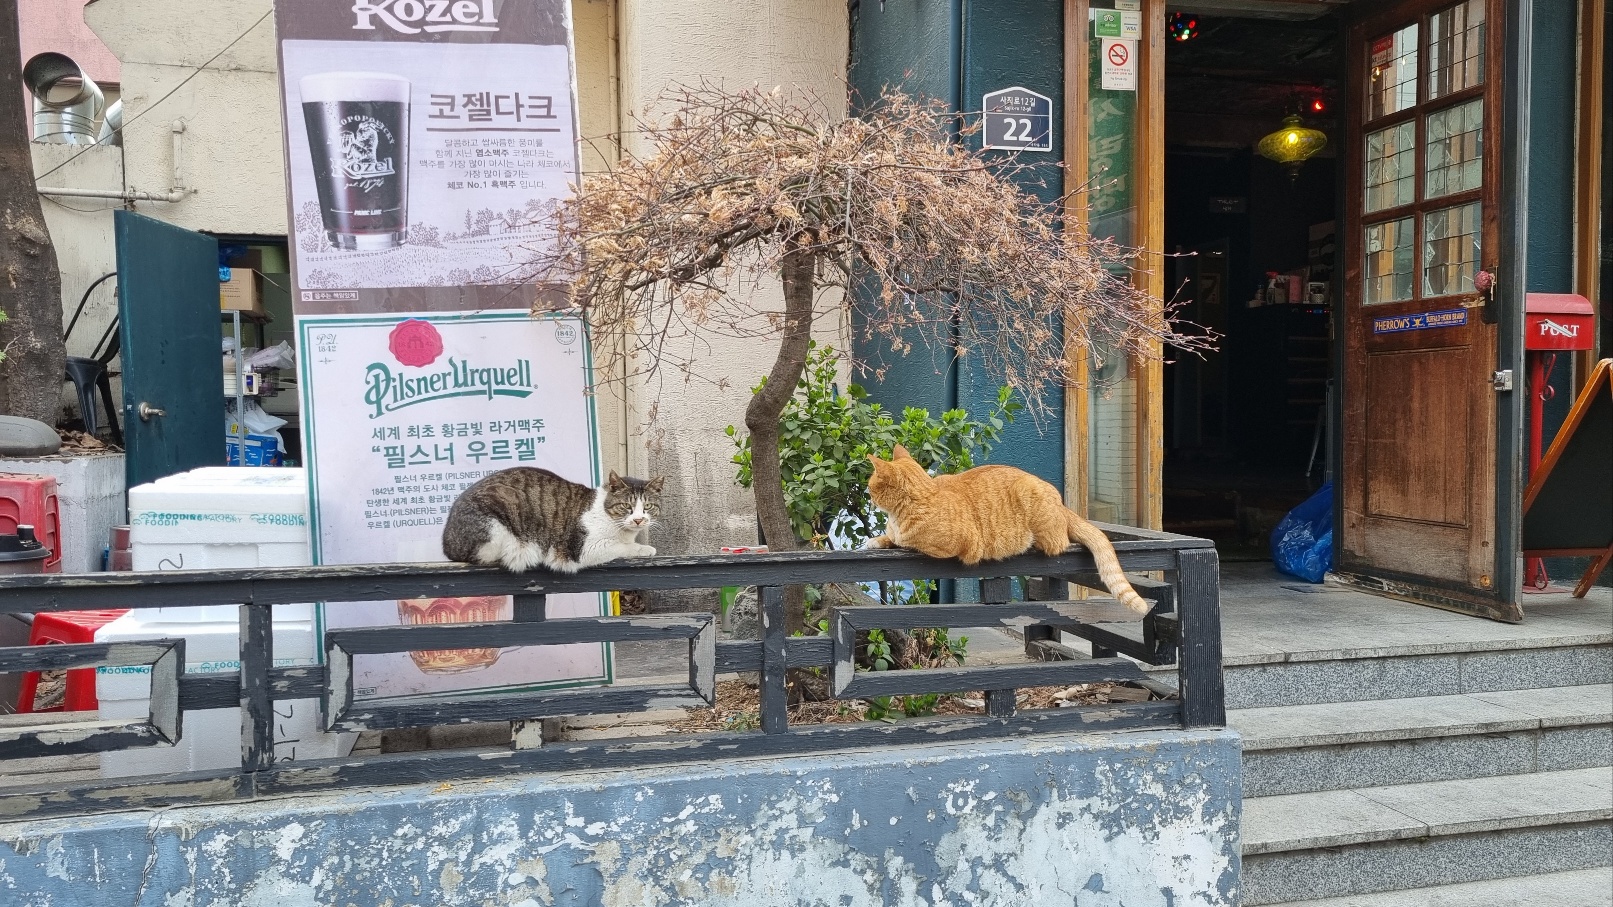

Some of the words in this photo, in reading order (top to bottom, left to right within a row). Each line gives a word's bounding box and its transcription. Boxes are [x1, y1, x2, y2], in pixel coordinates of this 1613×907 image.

[428, 92, 557, 122] 코젤다크
[1000, 96, 1036, 107] 사직로12길
[1003, 117, 1033, 142] 22
[444, 138, 478, 148] 달콤하고
[481, 138, 516, 148] 쌉싸름한
[519, 138, 543, 147] 풍미를
[435, 149, 453, 158] 함께
[456, 149, 472, 157] 지닌
[475, 148, 509, 157] 염소맥주
[512, 149, 555, 158] 코젤다크는
[329, 157, 396, 179] Kozel
[419, 159, 445, 169] 맥주를
[449, 159, 466, 169] 가장
[469, 159, 486, 168] 많이
[489, 159, 514, 168] 마시는
[517, 159, 534, 168] 나라
[537, 159, 571, 169] 체코에서
[464, 170, 480, 178] 가장
[483, 170, 501, 178] 많이
[504, 169, 530, 178] 즐기는
[447, 181, 464, 190] 체코
[467, 181, 487, 189] No.1
[490, 180, 517, 189] 흑맥주
[520, 181, 547, 190] 입니다.
[1374, 318, 1410, 331] PHERROW'S
[365, 362, 451, 419] Pilsner
[449, 356, 532, 401] Urquell
[371, 425, 401, 441] 세계
[407, 424, 436, 440] 최초
[441, 421, 483, 438] 황금빛
[489, 418, 546, 435] 라거맥주
[371, 442, 455, 469] “필스너
[466, 436, 546, 464] 우르켈”
[394, 474, 417, 484] 필스너
[420, 472, 443, 481] 우르켈
[445, 470, 480, 480] (PILSNER
[397, 485, 420, 494] 맥주의
[423, 484, 439, 492] 도시
[441, 483, 456, 491] 체코
[366, 498, 390, 508] 탄생한
[392, 497, 408, 506] 세계
[410, 496, 426, 504] 최초
[428, 494, 451, 503] 황금빛
[367, 521, 391, 530] 우르켈
[392, 516, 444, 528] (URQUELL)은
